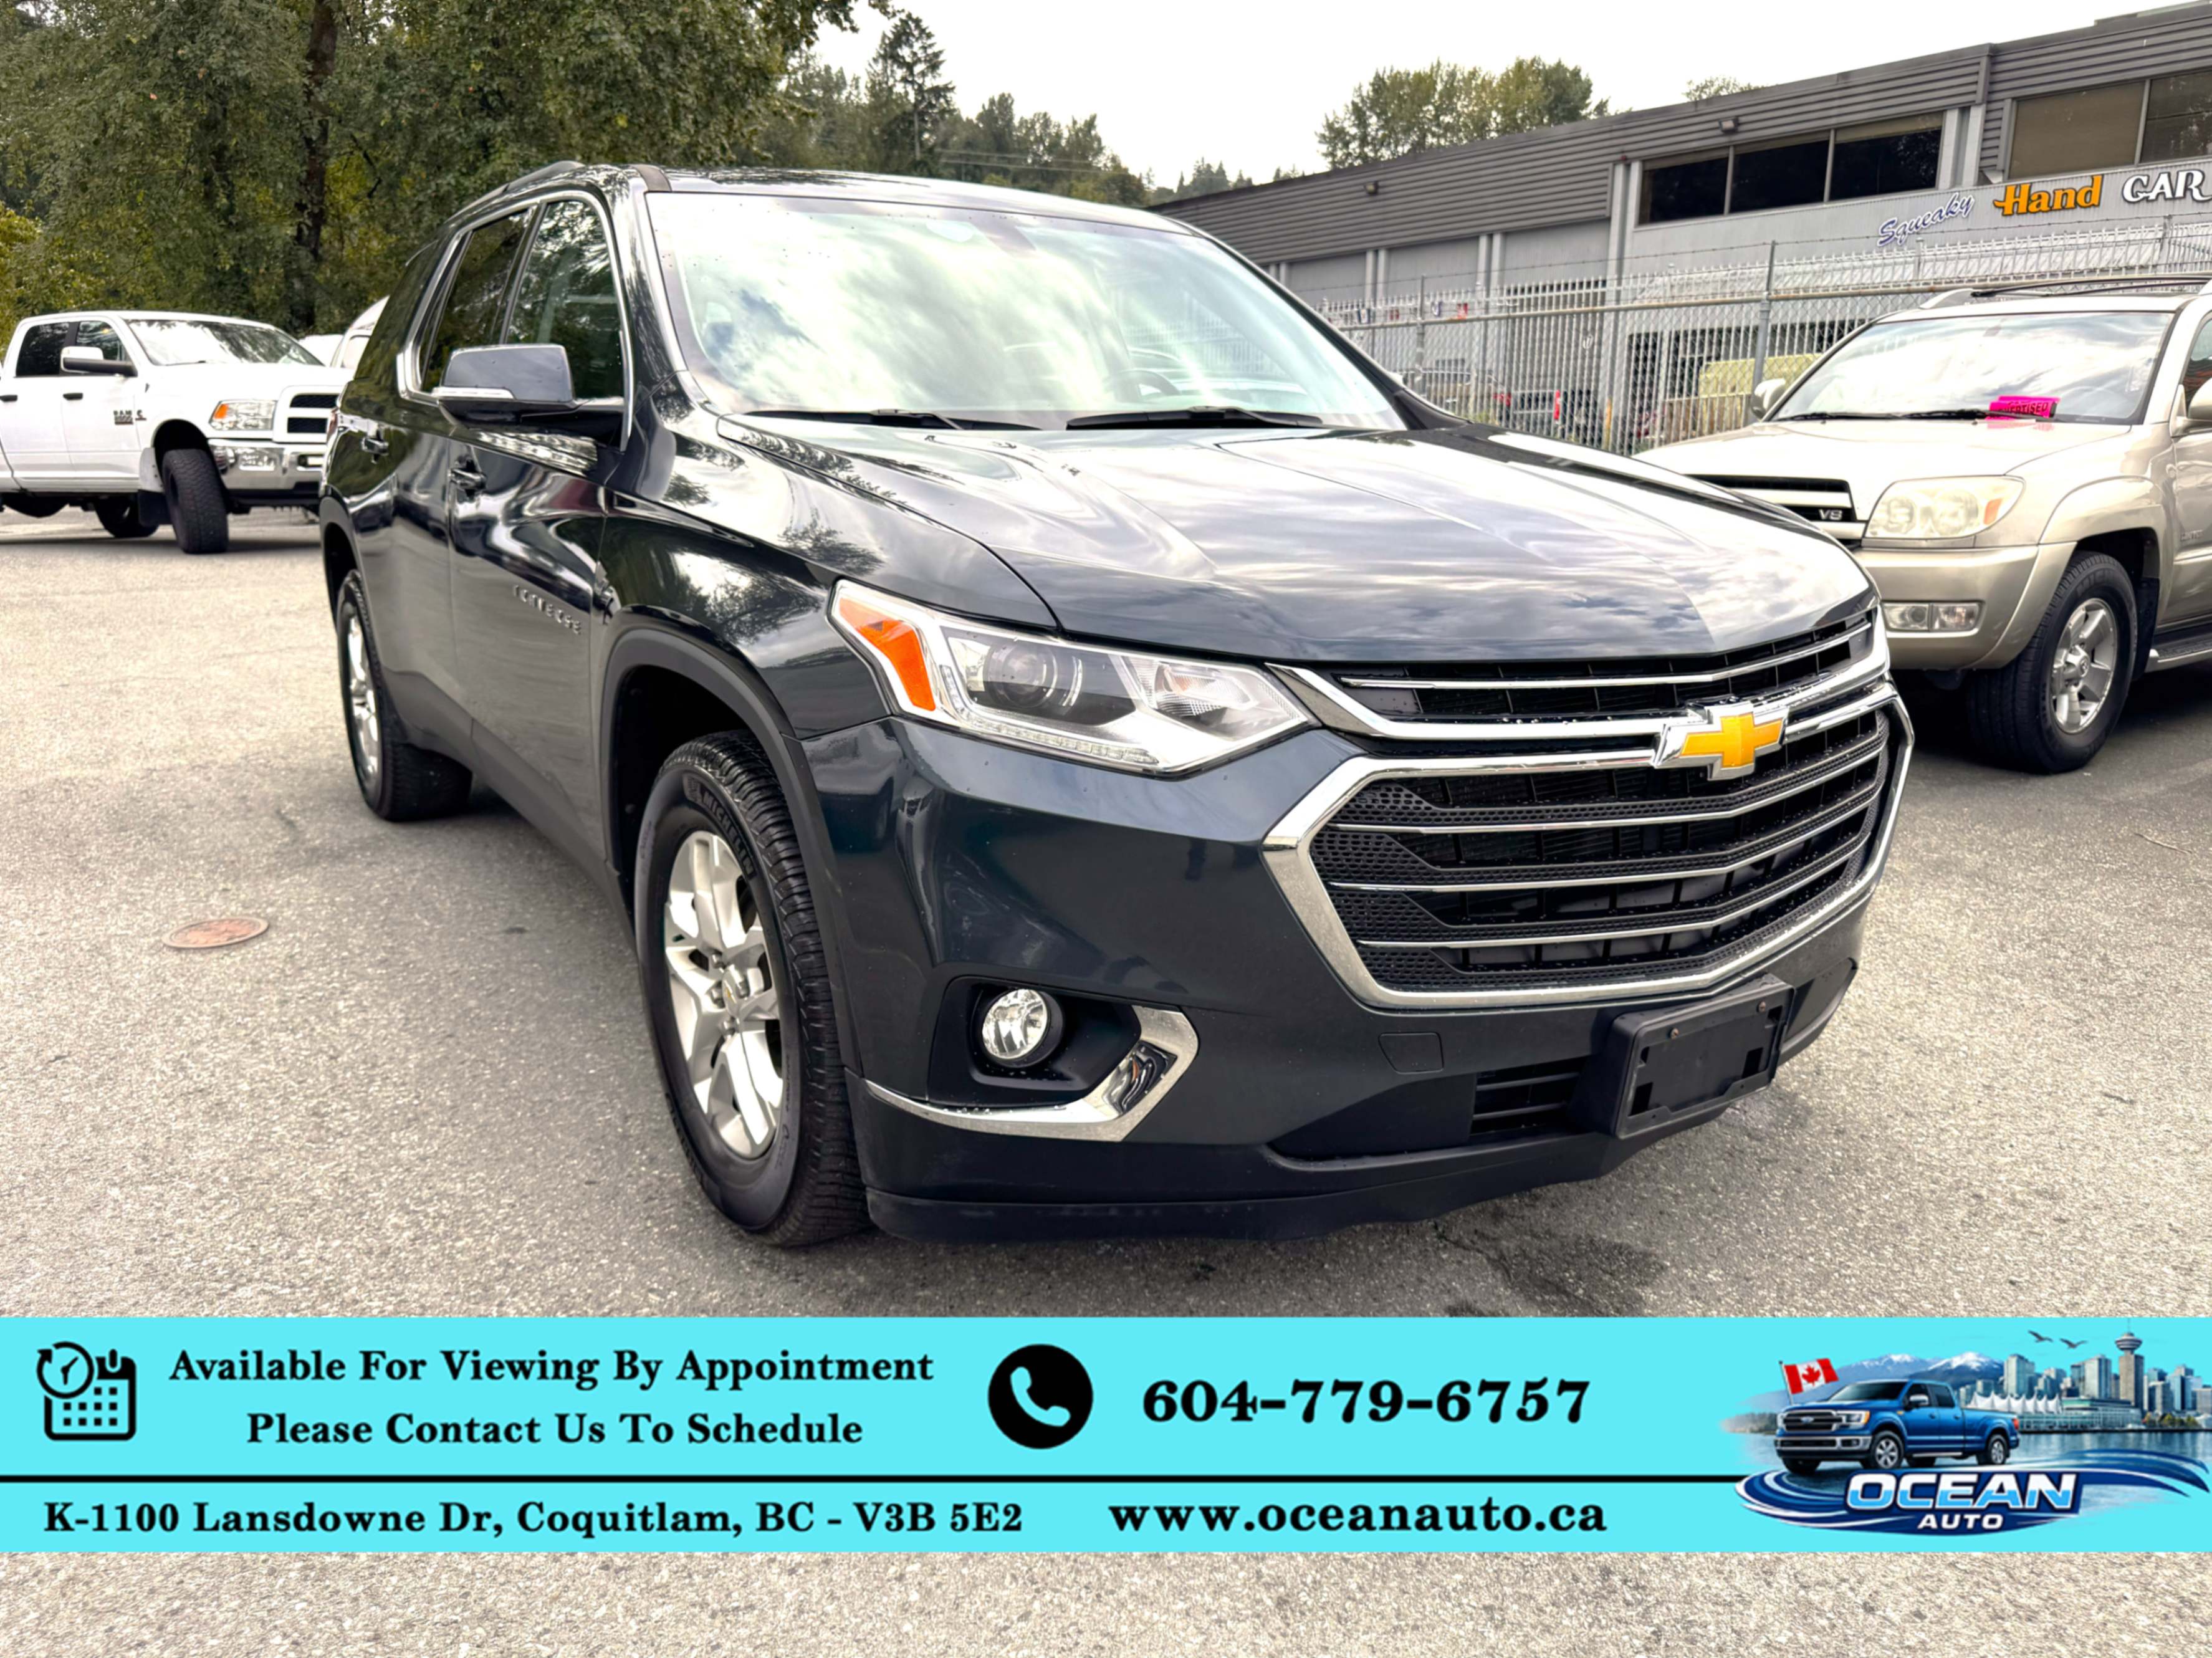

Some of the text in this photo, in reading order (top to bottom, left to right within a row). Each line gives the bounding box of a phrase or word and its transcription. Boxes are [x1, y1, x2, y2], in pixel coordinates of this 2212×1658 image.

[1877, 169, 2212, 247] Squeaky Hand CAR
[703, 790, 754, 874] MICHELIN
